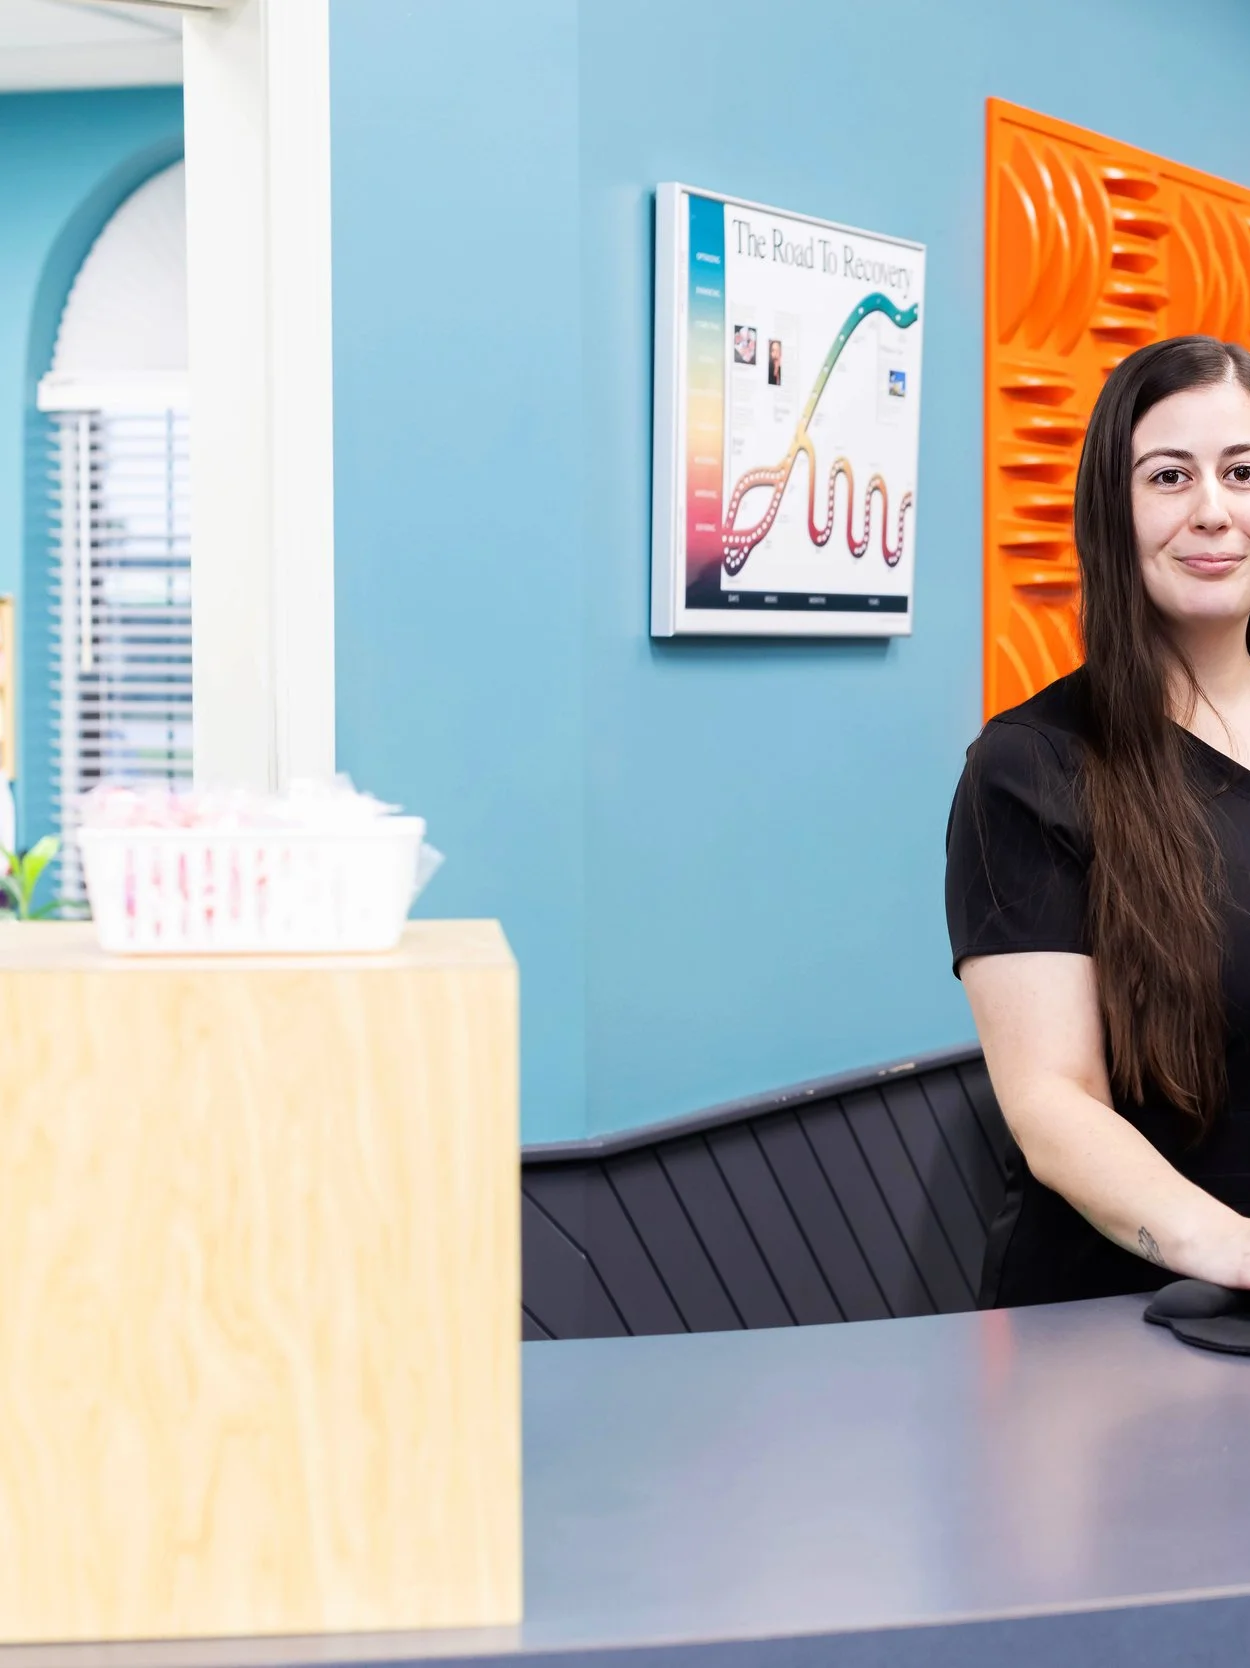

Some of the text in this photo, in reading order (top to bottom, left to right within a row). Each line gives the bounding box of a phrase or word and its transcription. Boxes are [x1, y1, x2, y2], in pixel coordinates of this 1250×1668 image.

[732, 219, 912, 299] The Road To Recovery
